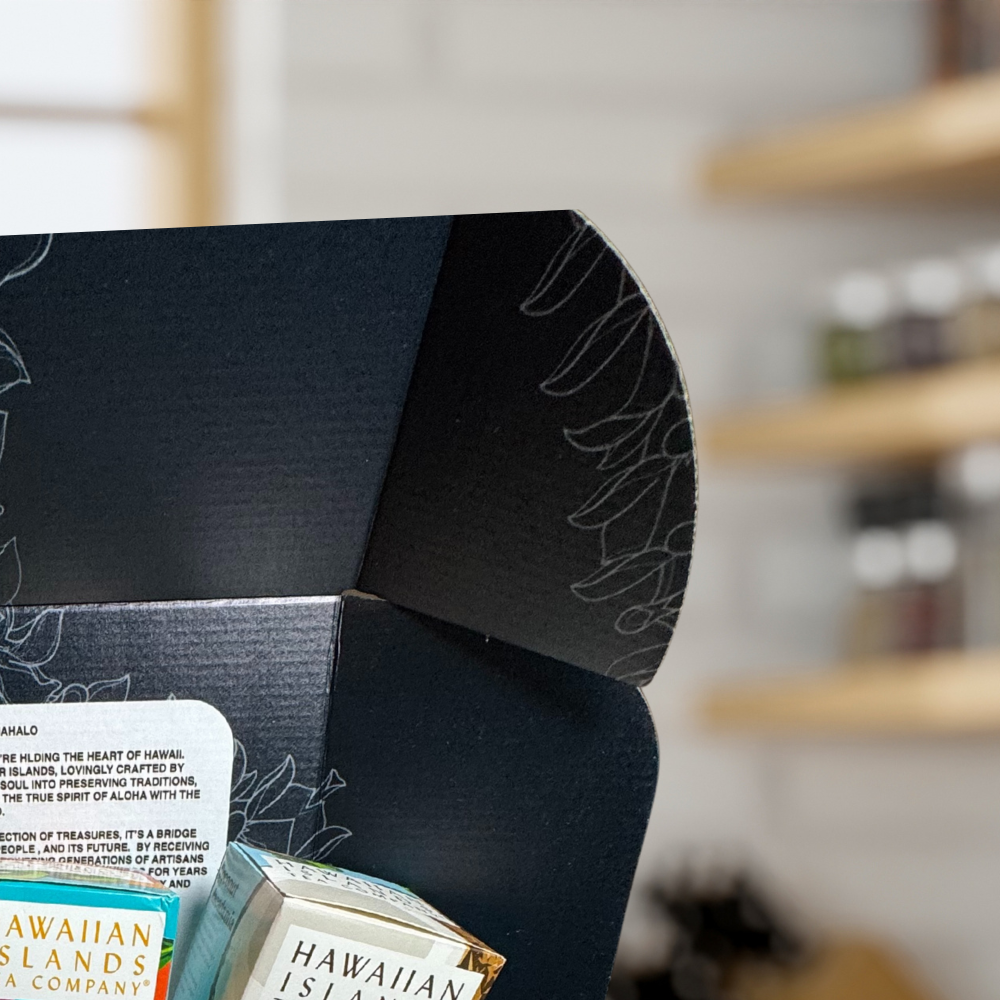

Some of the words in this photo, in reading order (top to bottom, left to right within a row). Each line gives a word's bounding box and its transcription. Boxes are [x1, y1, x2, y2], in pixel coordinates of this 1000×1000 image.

[20, 753, 60, 763] HLDING
[64, 752, 84, 762] THE
[87, 751, 123, 761] HEART
[127, 750, 141, 760] OF
[145, 750, 184, 760] HAWAII.
[9, 766, 57, 777] ISLANDS,
[61, 765, 113, 775] LOVINGLY
[117, 764, 166, 774] CRAFTED
[170, 763, 184, 773] BY
[0, 780, 28, 790] SOUL
[32, 779, 55, 789] INTO
[60, 778, 127, 788] PRESERVING
[130, 776, 197, 787] TRADITIONS,
[3, 794, 22, 803] THE
[26, 793, 53, 802] TRUE
[57, 792, 90, 802] SPIRIT
[94, 792, 107, 801] OF
[110, 791, 147, 800] ALOHA
[150, 790, 176, 799] WITH
[179, 790, 200, 799] THE
[40, 832, 53, 841] OF
[57, 830, 122, 841] TREASURES,
[126, 830, 144, 839] IT'S
[147, 830, 153, 838] A
[157, 828, 197, 838] BRIDGE
[44, 845, 64, 853] AND
[68, 844, 83, 853] ITS
[87, 843, 130, 852] FUTURE.
[137, 842, 151, 851] BY
[154, 841, 209, 851] RECEIVING
[135, 855, 149, 864] OF
[152, 854, 204, 864] ARTISANS
[149, 868, 169, 876] FOR
[173, 867, 207, 875] YEARS
[169, 880, 190, 888] AND
